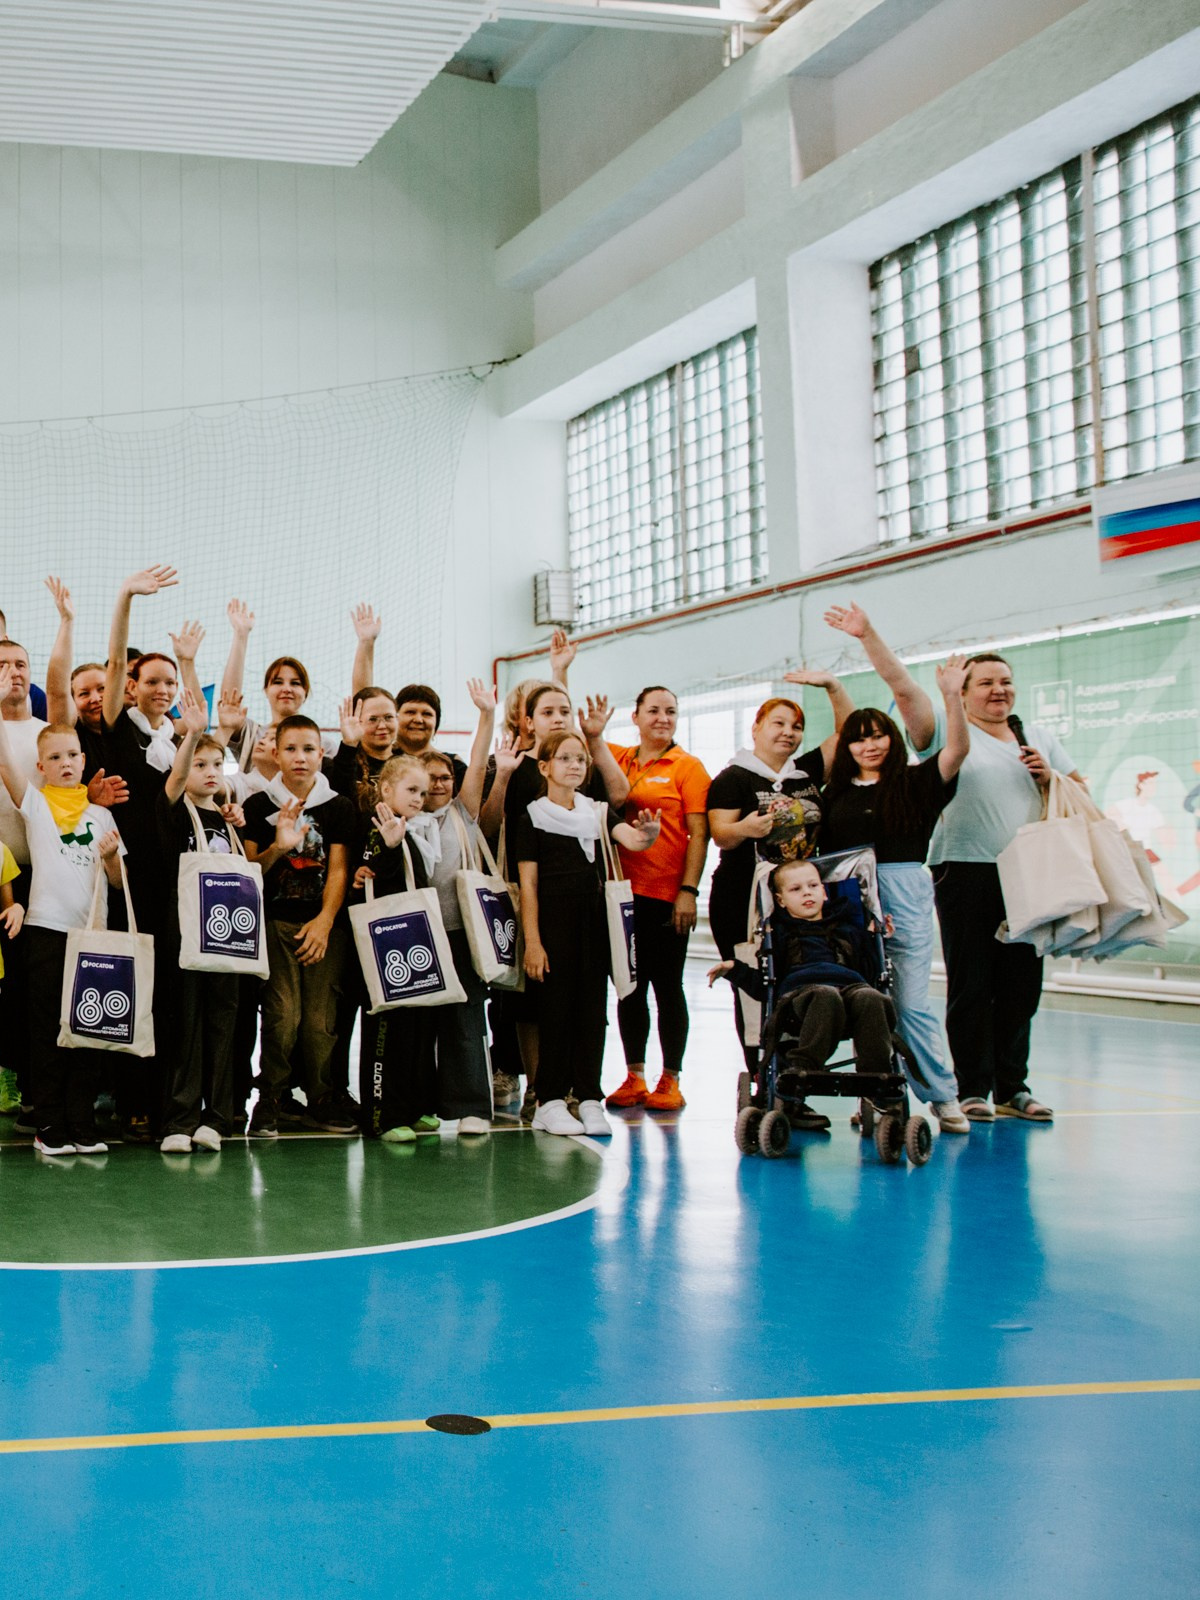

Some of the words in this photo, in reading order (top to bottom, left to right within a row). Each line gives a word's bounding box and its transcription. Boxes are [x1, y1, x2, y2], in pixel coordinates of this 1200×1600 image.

[206, 904, 256, 941] 80
[382, 922, 408, 932] РОСАТОМ
[88, 961, 114, 970] РОСАТОМ
[385, 945, 433, 987] 80
[76, 987, 130, 1027] 80
